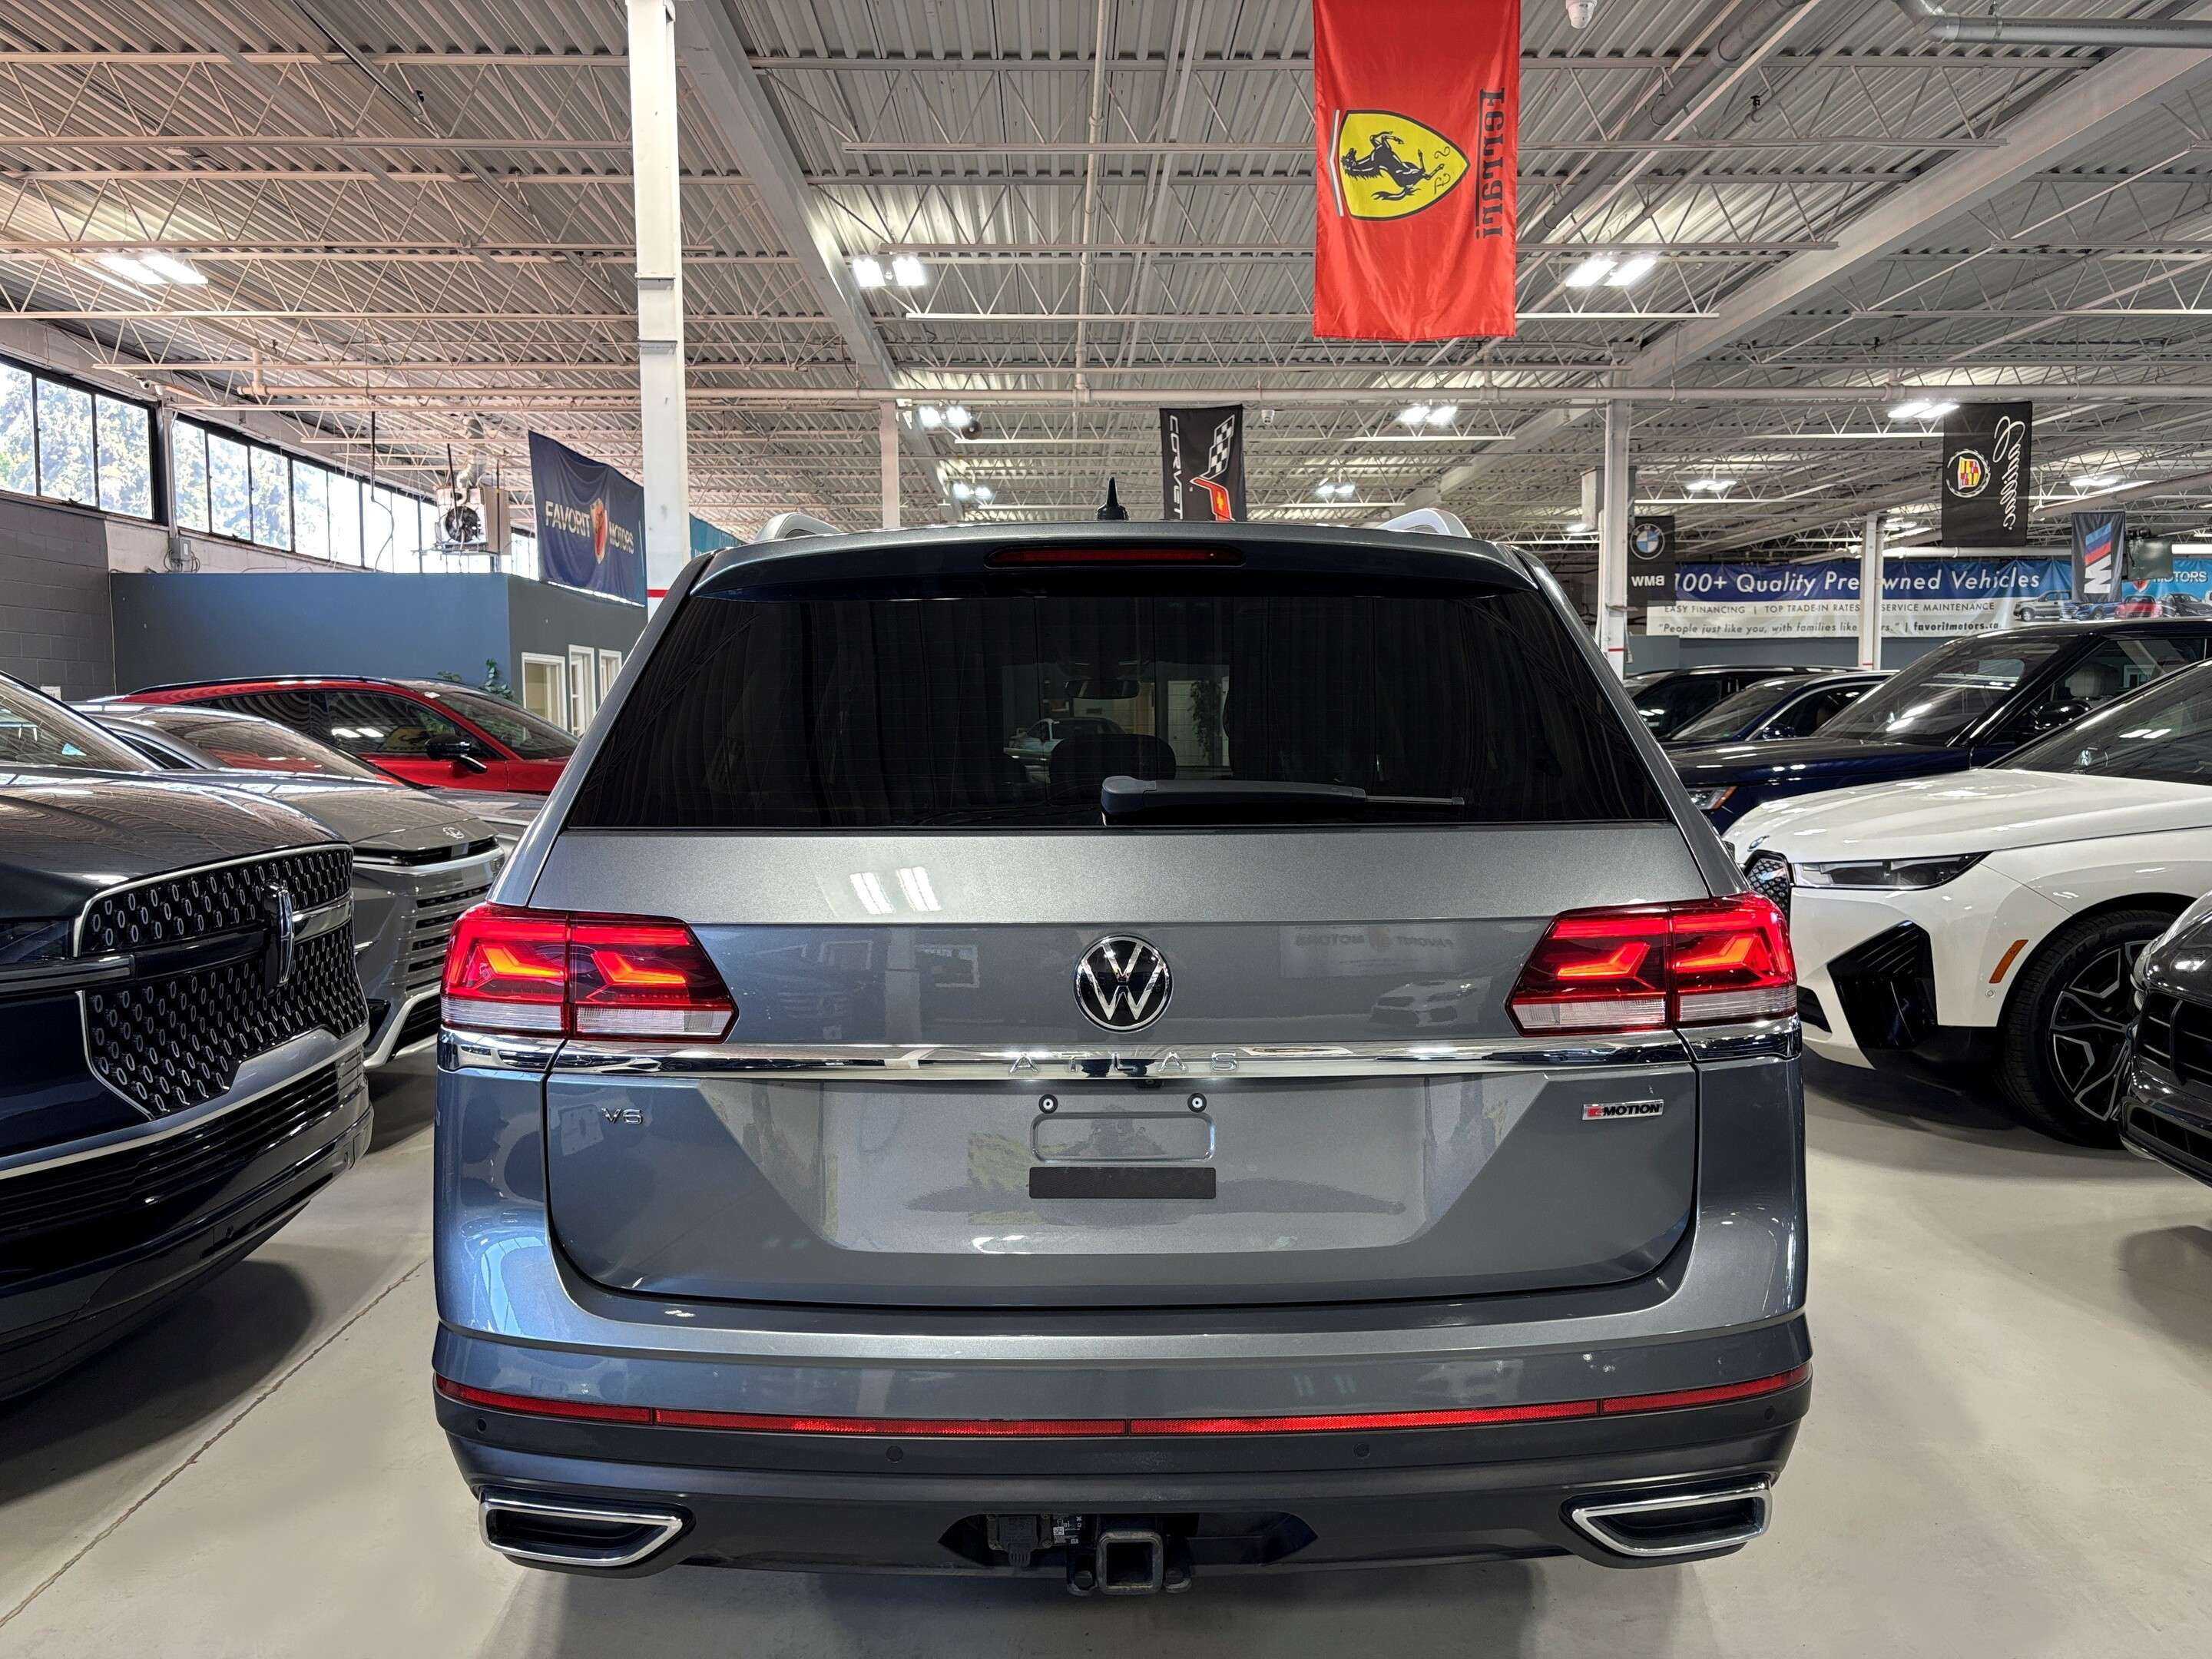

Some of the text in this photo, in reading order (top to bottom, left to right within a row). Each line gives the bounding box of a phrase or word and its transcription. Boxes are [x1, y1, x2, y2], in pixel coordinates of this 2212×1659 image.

[1170, 415, 1183, 520] CORVET
[545, 501, 634, 555] FAVORIT MOTORS
[1675, 573, 1727, 592] 100+
[1737, 571, 1816, 597] Quality
[1952, 566, 2040, 589] Vehicles
[1664, 605, 1688, 614] EASY
[1764, 605, 1783, 614] TOP
[1833, 604, 1860, 612] RATES
[1882, 602, 1995, 612] SERVICE MAINTENANCE
[1701, 624, 1720, 634] just
[1724, 624, 1743, 633] like
[1772, 623, 1793, 632] with
[1796, 622, 1836, 632] families
[1840, 621, 1857, 631] like
[1914, 621, 1998, 631] favoritmotors.ca
[1008, 1050, 1239, 1075] ATLAS
[601, 1108, 644, 1124] V6
